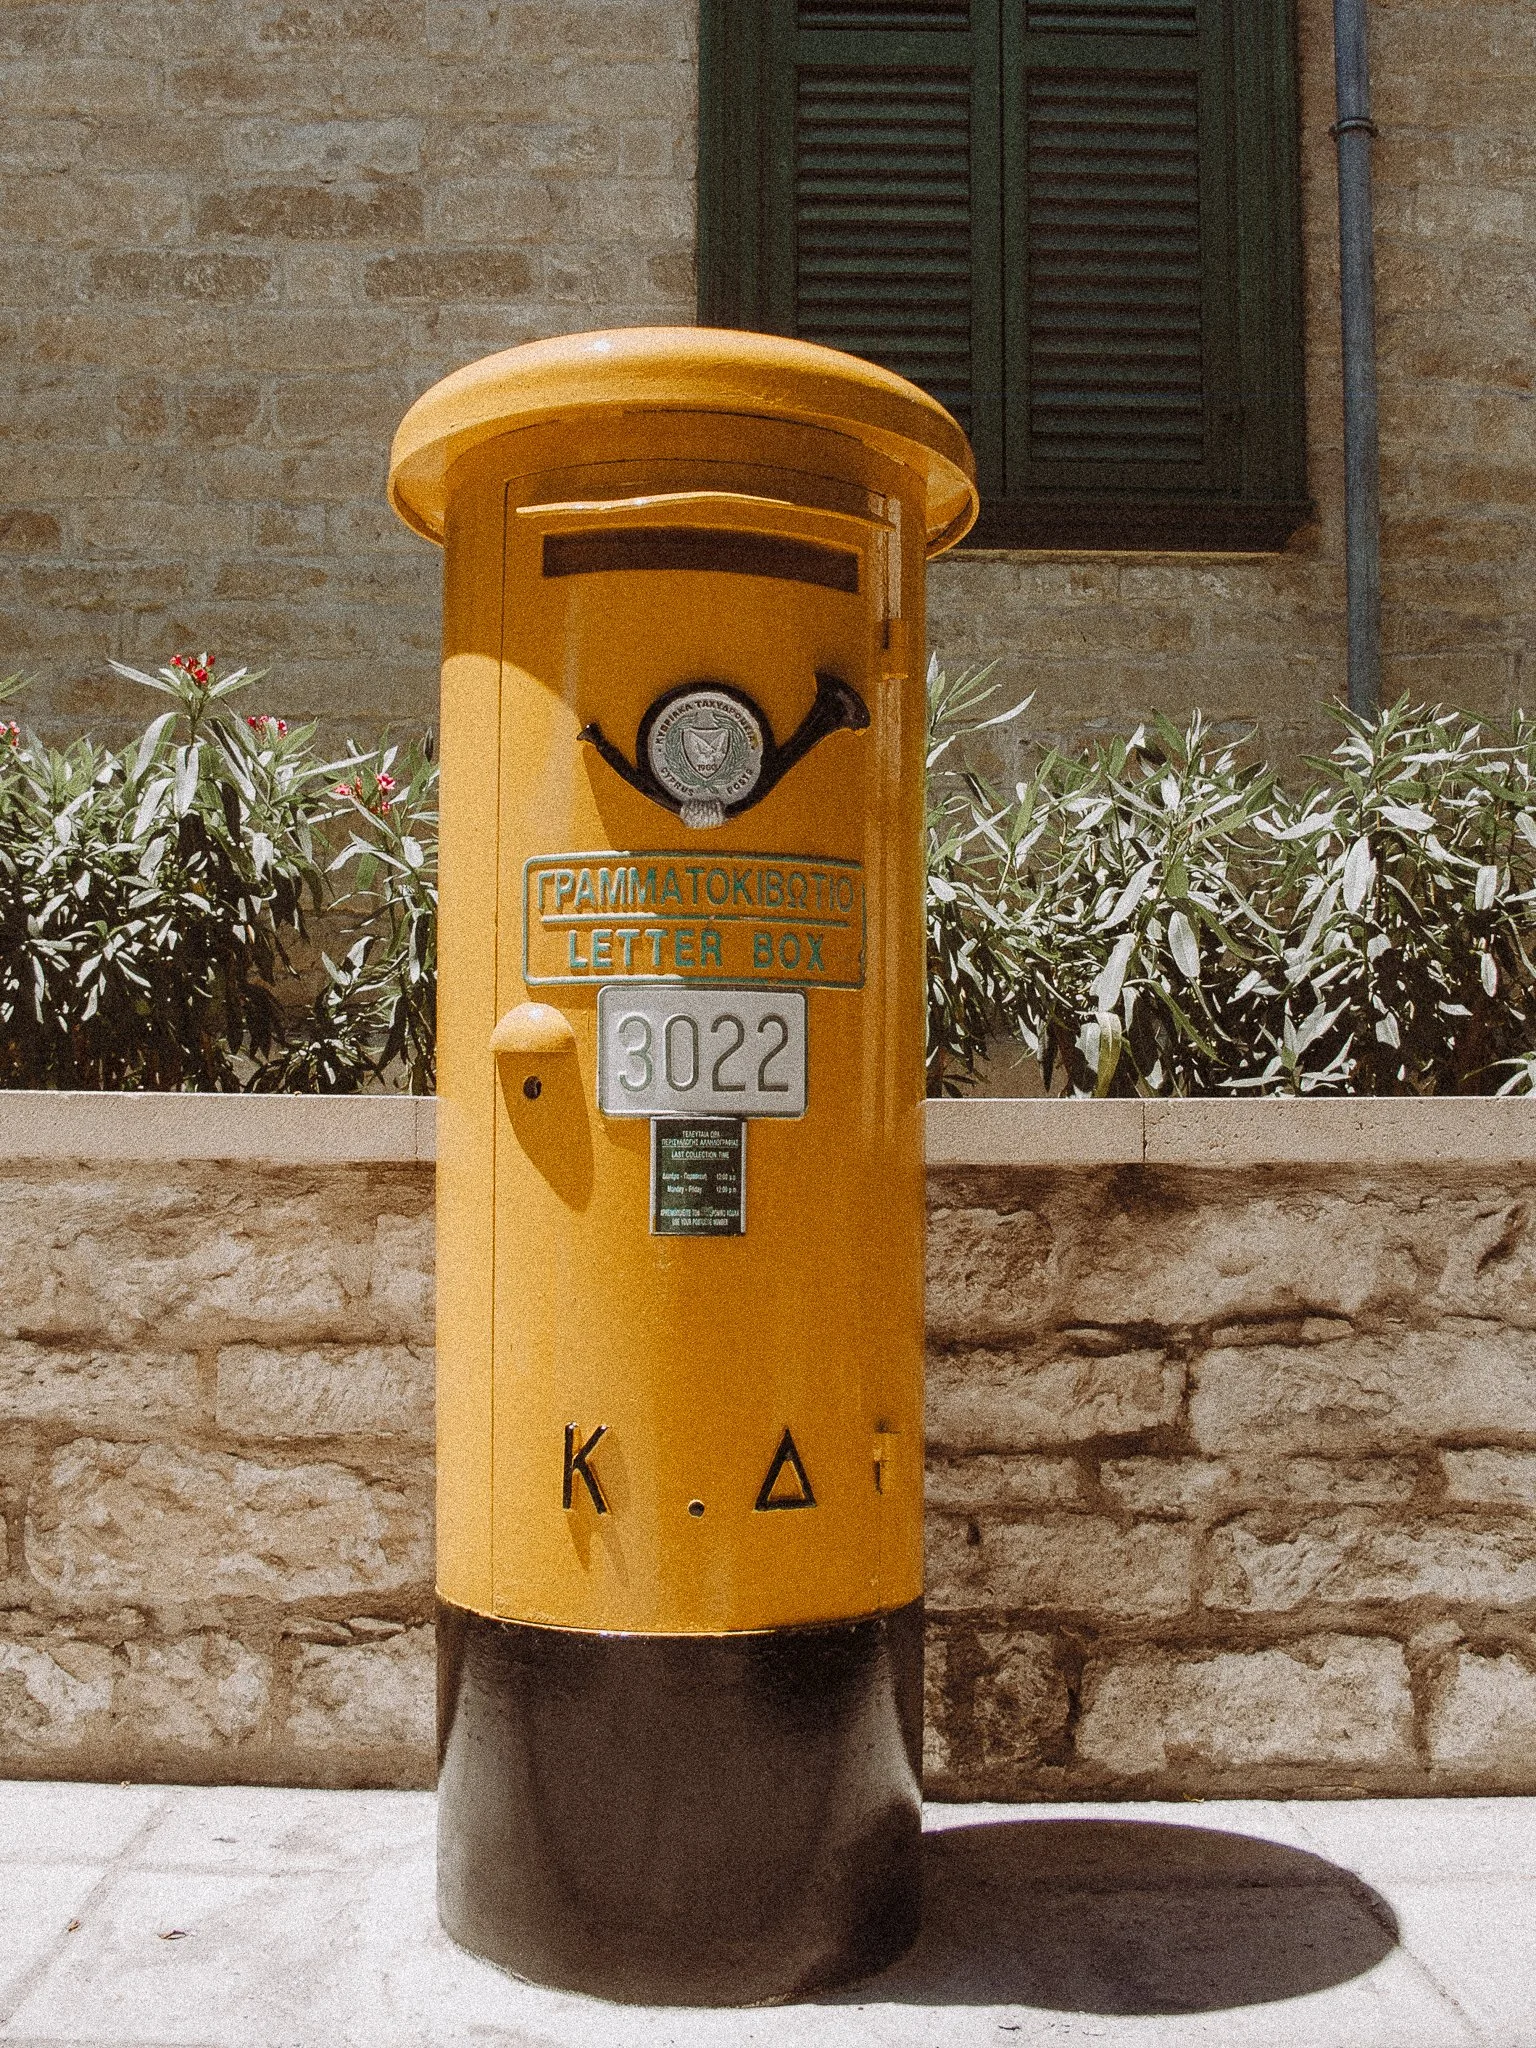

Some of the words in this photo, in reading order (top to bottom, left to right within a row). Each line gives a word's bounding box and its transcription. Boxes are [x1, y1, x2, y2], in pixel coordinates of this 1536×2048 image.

[660, 767, 694, 797] CYPRUS
[537, 866, 855, 913] ΓΡΑΜΜΑΤΟΚΙΒΩΤΙΟ
[568, 928, 723, 969] LETTER
[753, 931, 825, 972] BOX
[618, 1012, 789, 1093] 3022
[671, 1151, 684, 1159] LAST
[685, 1151, 717, 1159] COLLECTION
